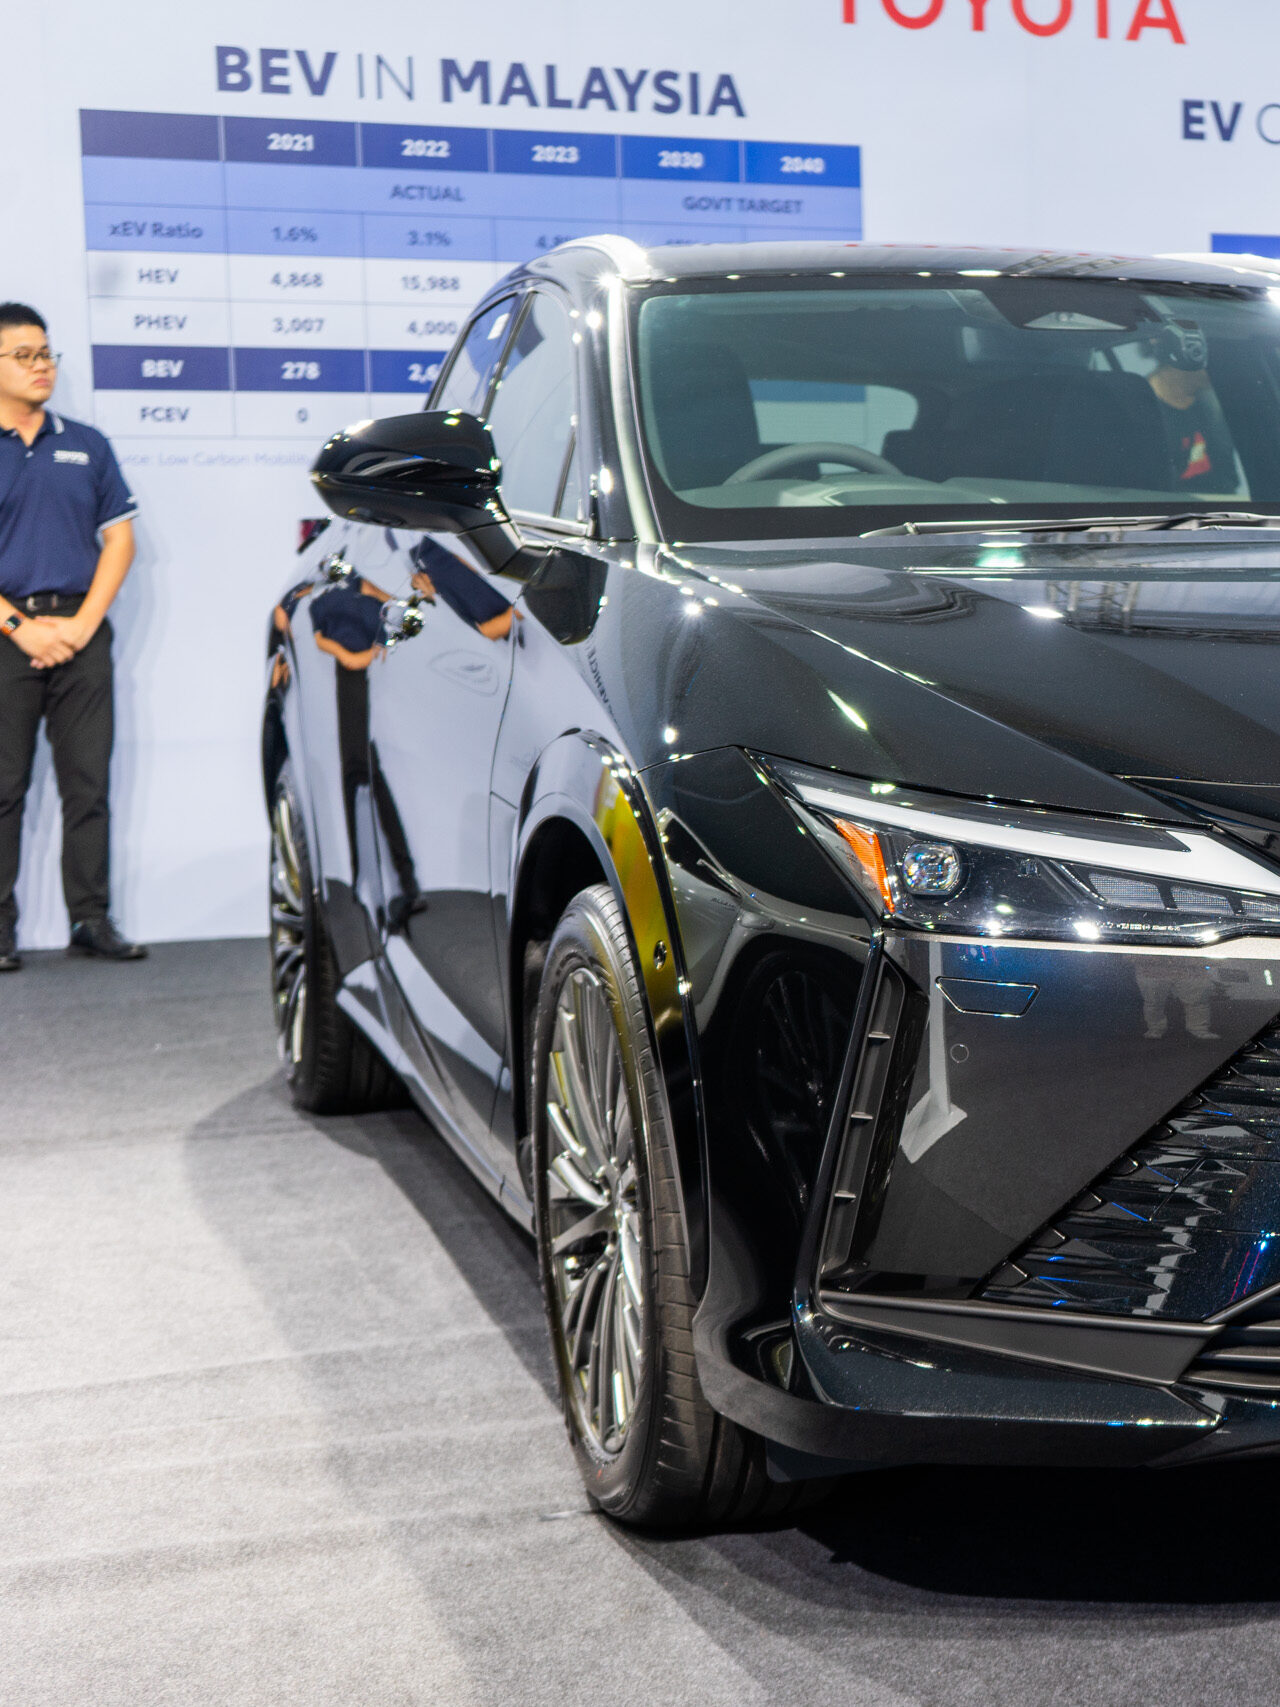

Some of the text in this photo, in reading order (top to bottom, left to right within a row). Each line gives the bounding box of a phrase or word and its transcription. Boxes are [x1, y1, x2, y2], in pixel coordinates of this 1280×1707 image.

[216, 45, 747, 118] BEV IN MALAYSIA
[1182, 98, 1243, 142] EV
[267, 133, 314, 151] 2021
[401, 138, 450, 158] 2022
[532, 144, 579, 163] 2023
[390, 183, 465, 201] ACTUAL
[682, 196, 803, 214] GOVT TARGET
[109, 220, 204, 239] xEV Ratio
[138, 267, 179, 284] HEV
[134, 314, 187, 330] PHEV
[141, 359, 184, 378] BEV
[281, 361, 322, 380] 278
[140, 406, 190, 422] FCEV
